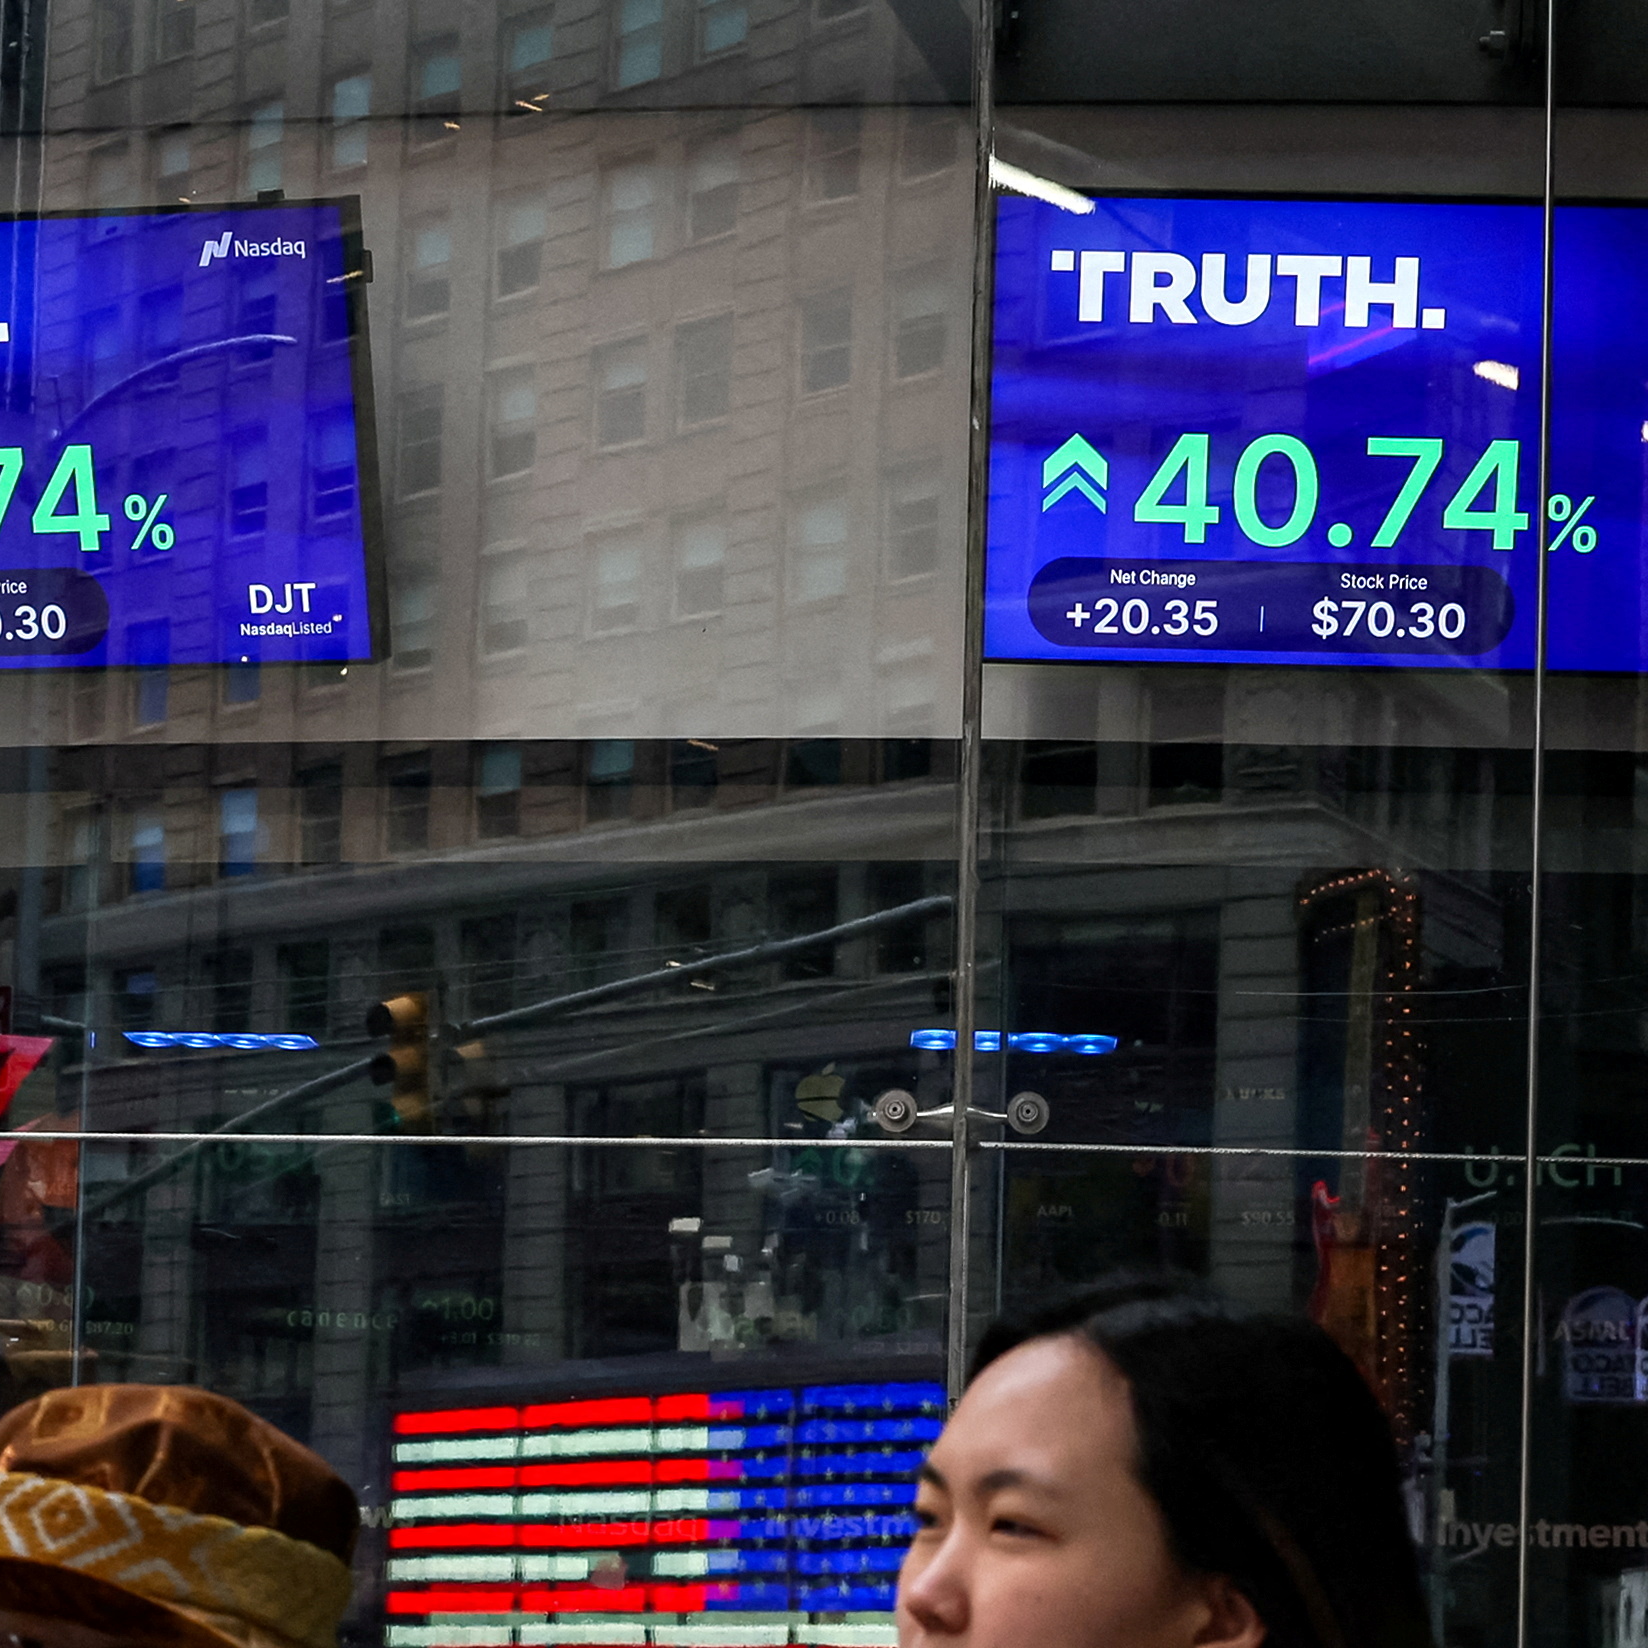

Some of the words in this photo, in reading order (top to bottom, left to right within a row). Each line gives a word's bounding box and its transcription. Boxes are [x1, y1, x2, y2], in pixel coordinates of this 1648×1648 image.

[234, 237, 307, 261] Nasdaq
[1051, 250, 1446, 330] TRUTH.
[1110, 569, 1138, 588] Net
[1141, 568, 1196, 591] Change
[1340, 573, 1384, 592] Stock
[1388, 573, 1428, 592] Price
[249, 583, 317, 617] DJT
[1065, 597, 1219, 637] +20.35
[1311, 598, 1465, 641] $70.30
